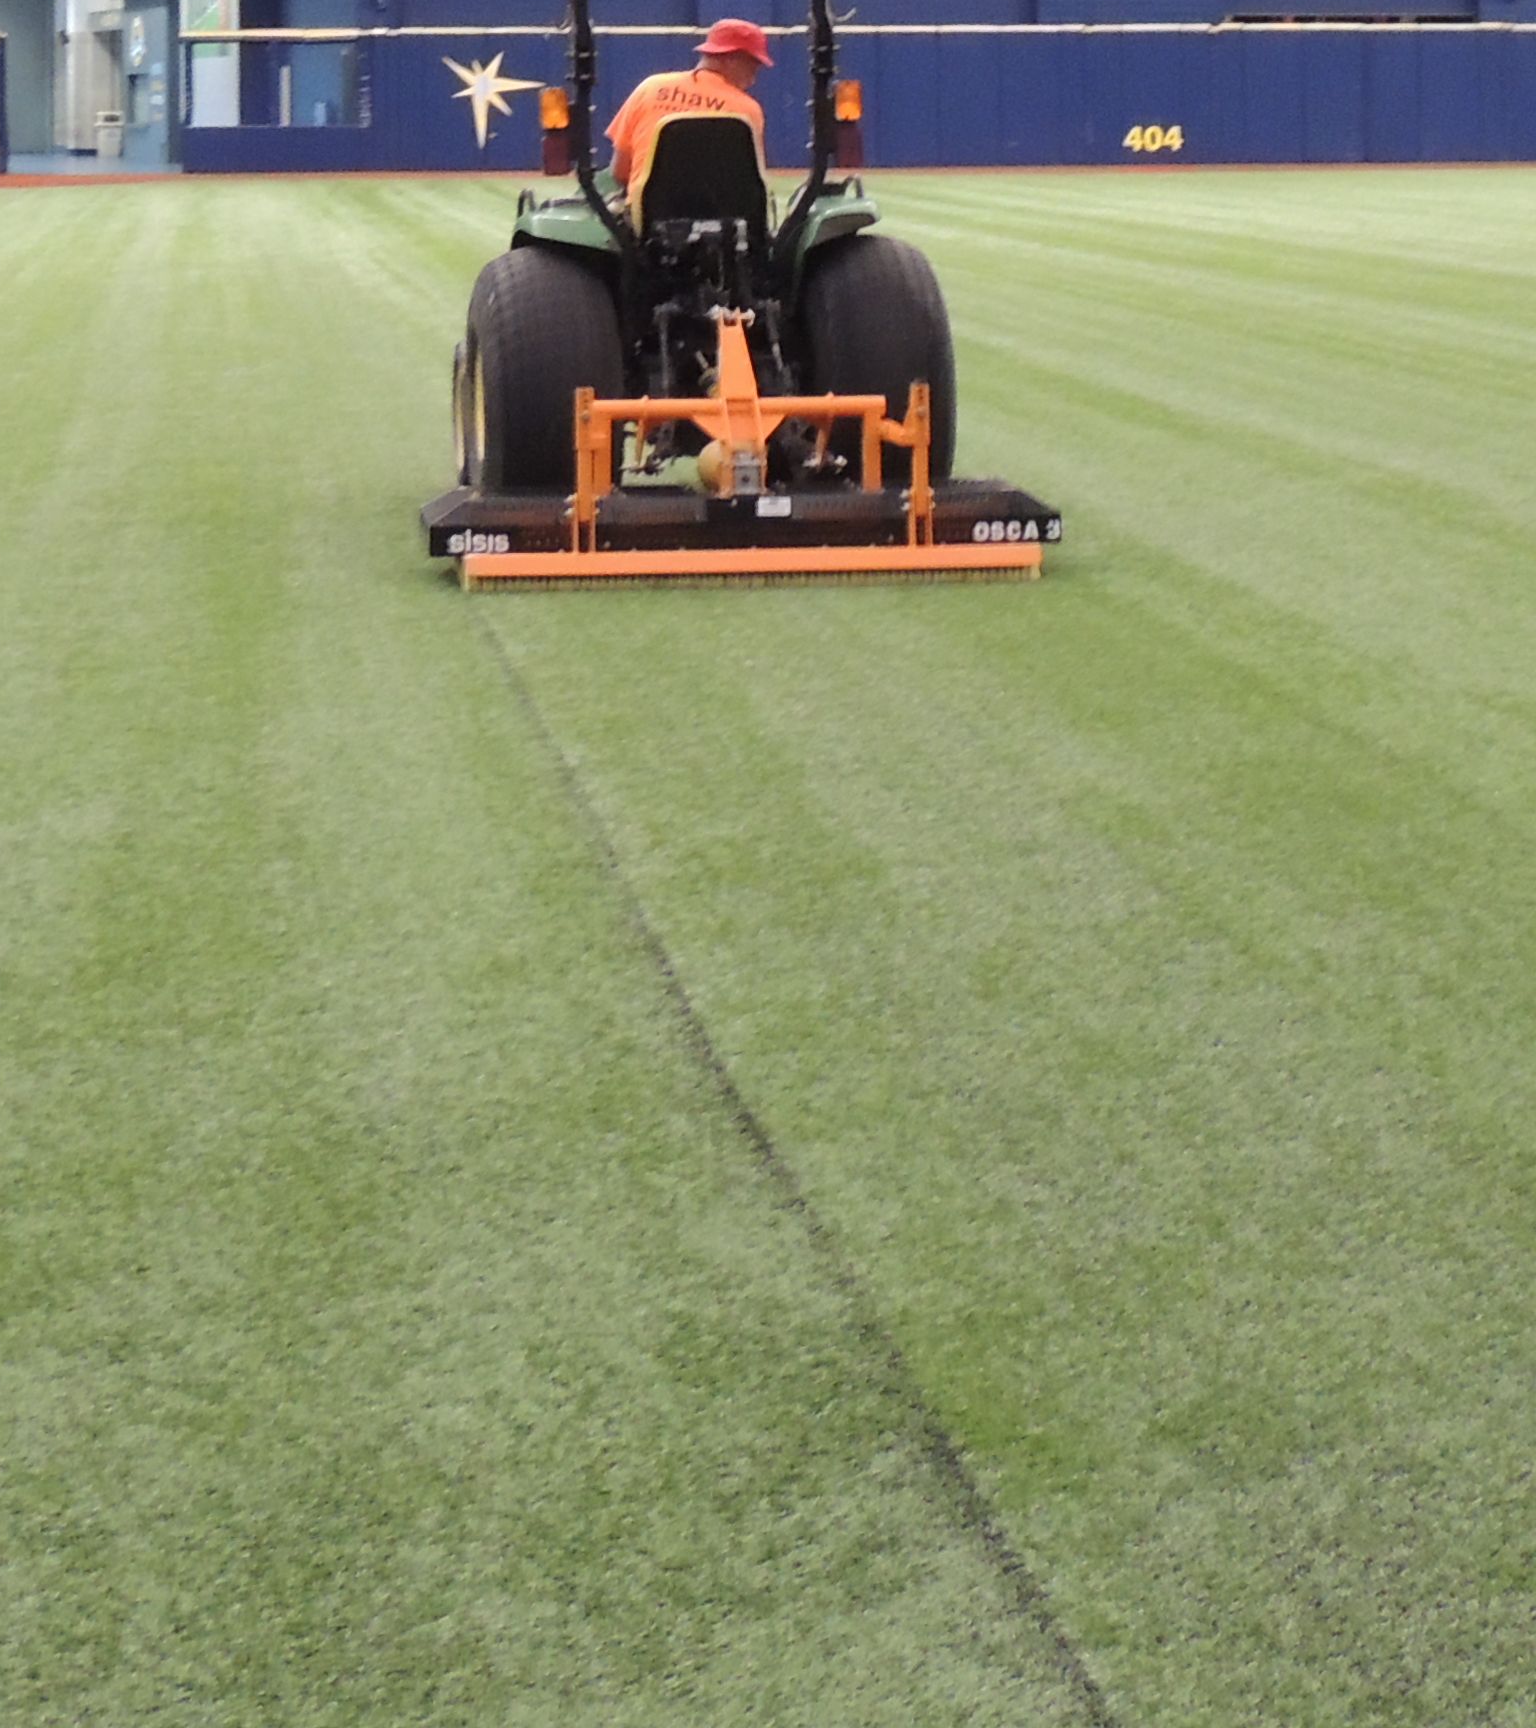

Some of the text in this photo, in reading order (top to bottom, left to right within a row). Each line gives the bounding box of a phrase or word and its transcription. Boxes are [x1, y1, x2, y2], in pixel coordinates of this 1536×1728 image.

[655, 85, 726, 111] shaw
[1122, 123, 1185, 153] 404
[972, 519, 1040, 543] OSCA
